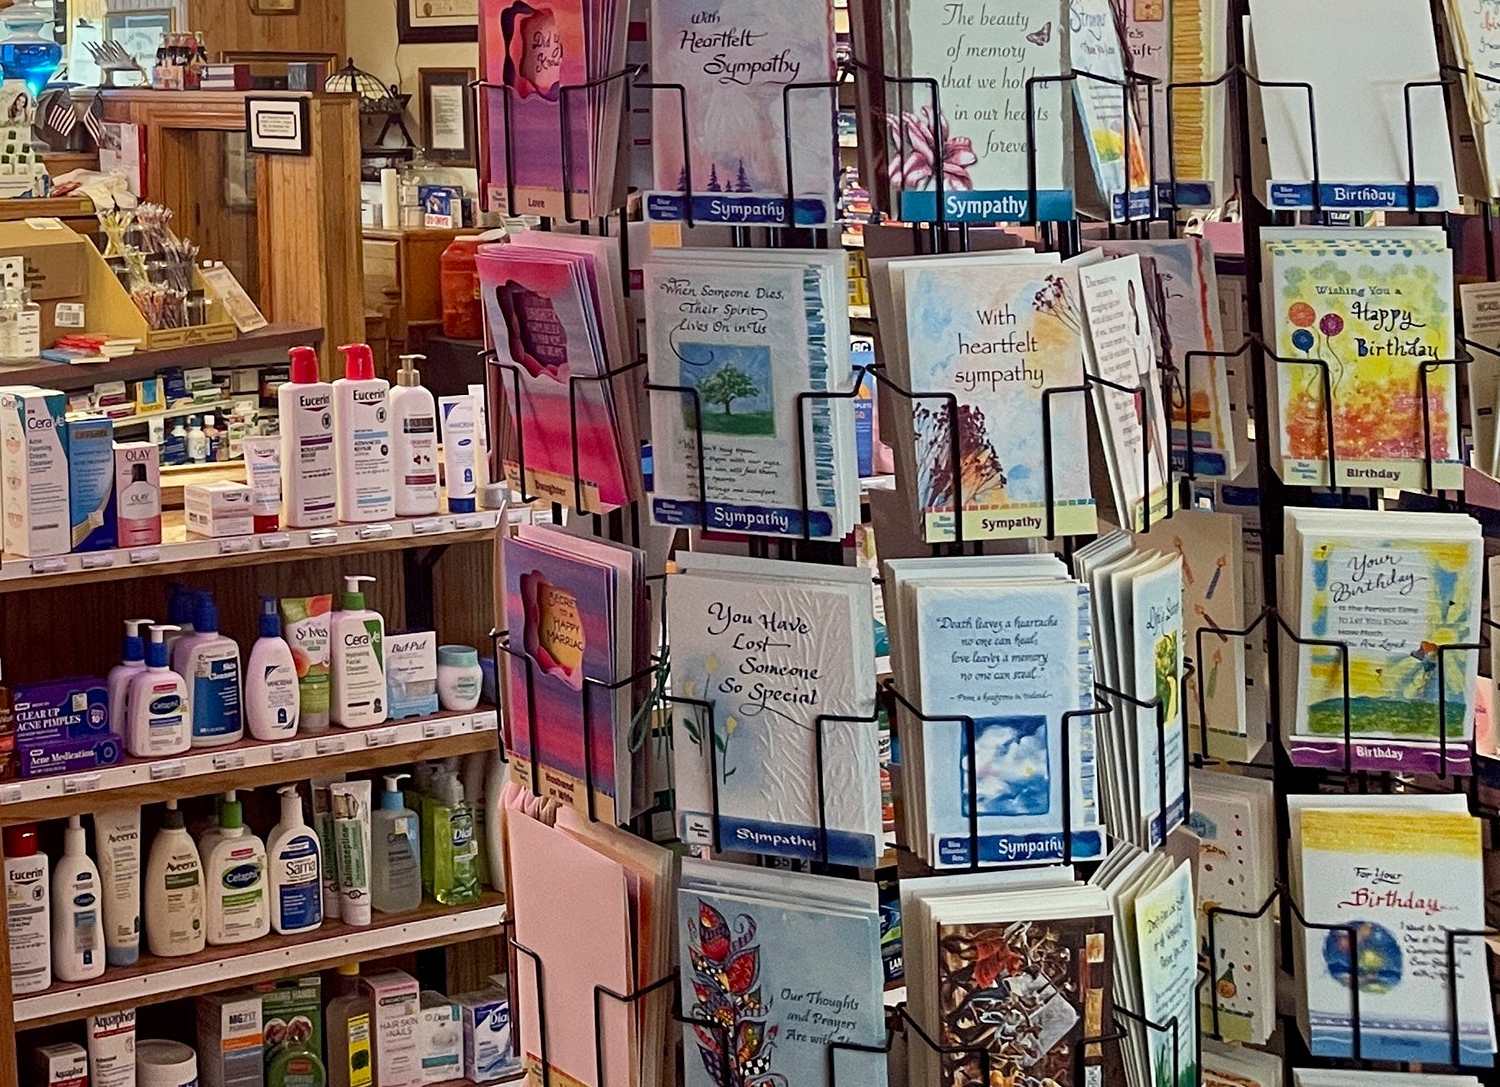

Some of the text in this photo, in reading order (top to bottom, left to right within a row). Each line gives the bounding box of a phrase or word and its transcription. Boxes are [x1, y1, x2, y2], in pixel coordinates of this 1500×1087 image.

[690, 10, 722, 25] With
[941, 2, 1031, 29] The beauty
[678, 28, 770, 52] Heartfelt
[946, 35, 1027, 63] of memory
[702, 48, 801, 87] Sympathy
[941, 67, 972, 90] that
[976, 75, 997, 90] we
[954, 98, 1050, 122] in our heats
[527, 197, 546, 210] Love
[1333, 186, 1397, 207] Birthday
[709, 200, 786, 223] Sympathy
[945, 195, 1029, 220] Sympathy
[659, 277, 698, 300] When
[700, 284, 751, 301] Someone
[1314, 285, 1403, 297] Wishing You a
[678, 301, 769, 322] Their Spirit
[975, 303, 1017, 326] With
[1349, 300, 1427, 333] Happy
[674, 319, 768, 336] Lives On in Us
[957, 330, 1039, 355] heartfelt
[1353, 336, 1440, 374] Birthday
[954, 362, 1045, 393] sympathy
[300, 394, 331, 407] Eucerin
[352, 388, 387, 401] Eucerin
[27, 415, 66, 430] CeraVe
[125, 449, 151, 461] OLAY
[1346, 466, 1402, 481] Birthday
[534, 479, 567, 497] Daughter
[714, 506, 789, 533] Sympathy
[981, 515, 1043, 532] Sympathy
[1347, 554, 1404, 583] Your
[1329, 568, 1428, 604] Birthday
[553, 617, 581, 634] HAPPY
[706, 600, 812, 636] You Have
[974, 616, 1004, 634] leaves
[1004, 619, 1012, 629] a
[1013, 613, 1059, 629] heartache
[308, 626, 329, 638] Ives
[344, 632, 382, 647] CeraVe
[731, 632, 792, 653] Lost
[960, 637, 974, 647] no
[975, 636, 993, 648] one
[994, 637, 1012, 647] can
[738, 656, 824, 681] Someone
[951, 650, 971, 664] love
[972, 650, 1001, 669] leaves
[1002, 653, 1010, 663] a
[960, 672, 973, 682] no
[975, 672, 992, 681] one
[993, 672, 1012, 681] can
[718, 676, 820, 717] So Special
[16, 707, 61, 722] CLEAR UP
[16, 713, 82, 732] ACNE PIMPLES
[30, 749, 95, 765] Acne Medication
[1356, 745, 1405, 762] Birthday
[107, 832, 139, 844] Aveeno
[453, 827, 472, 843] Dial
[736, 827, 818, 851] Sympathy
[997, 837, 1066, 863] Sympathy
[9, 868, 44, 881] Eucerin
[165, 860, 198, 872] Aveeno
[285, 860, 317, 877] Sarna
[1353, 866, 1403, 885] For Your
[780, 987, 860, 1015] Our Thoughts
[93, 1011, 135, 1030] Aquaphor
[786, 1008, 857, 1034] and Prayers
[785, 1028, 833, 1046] Are with
[54, 1067, 84, 1080] Aquaphor
